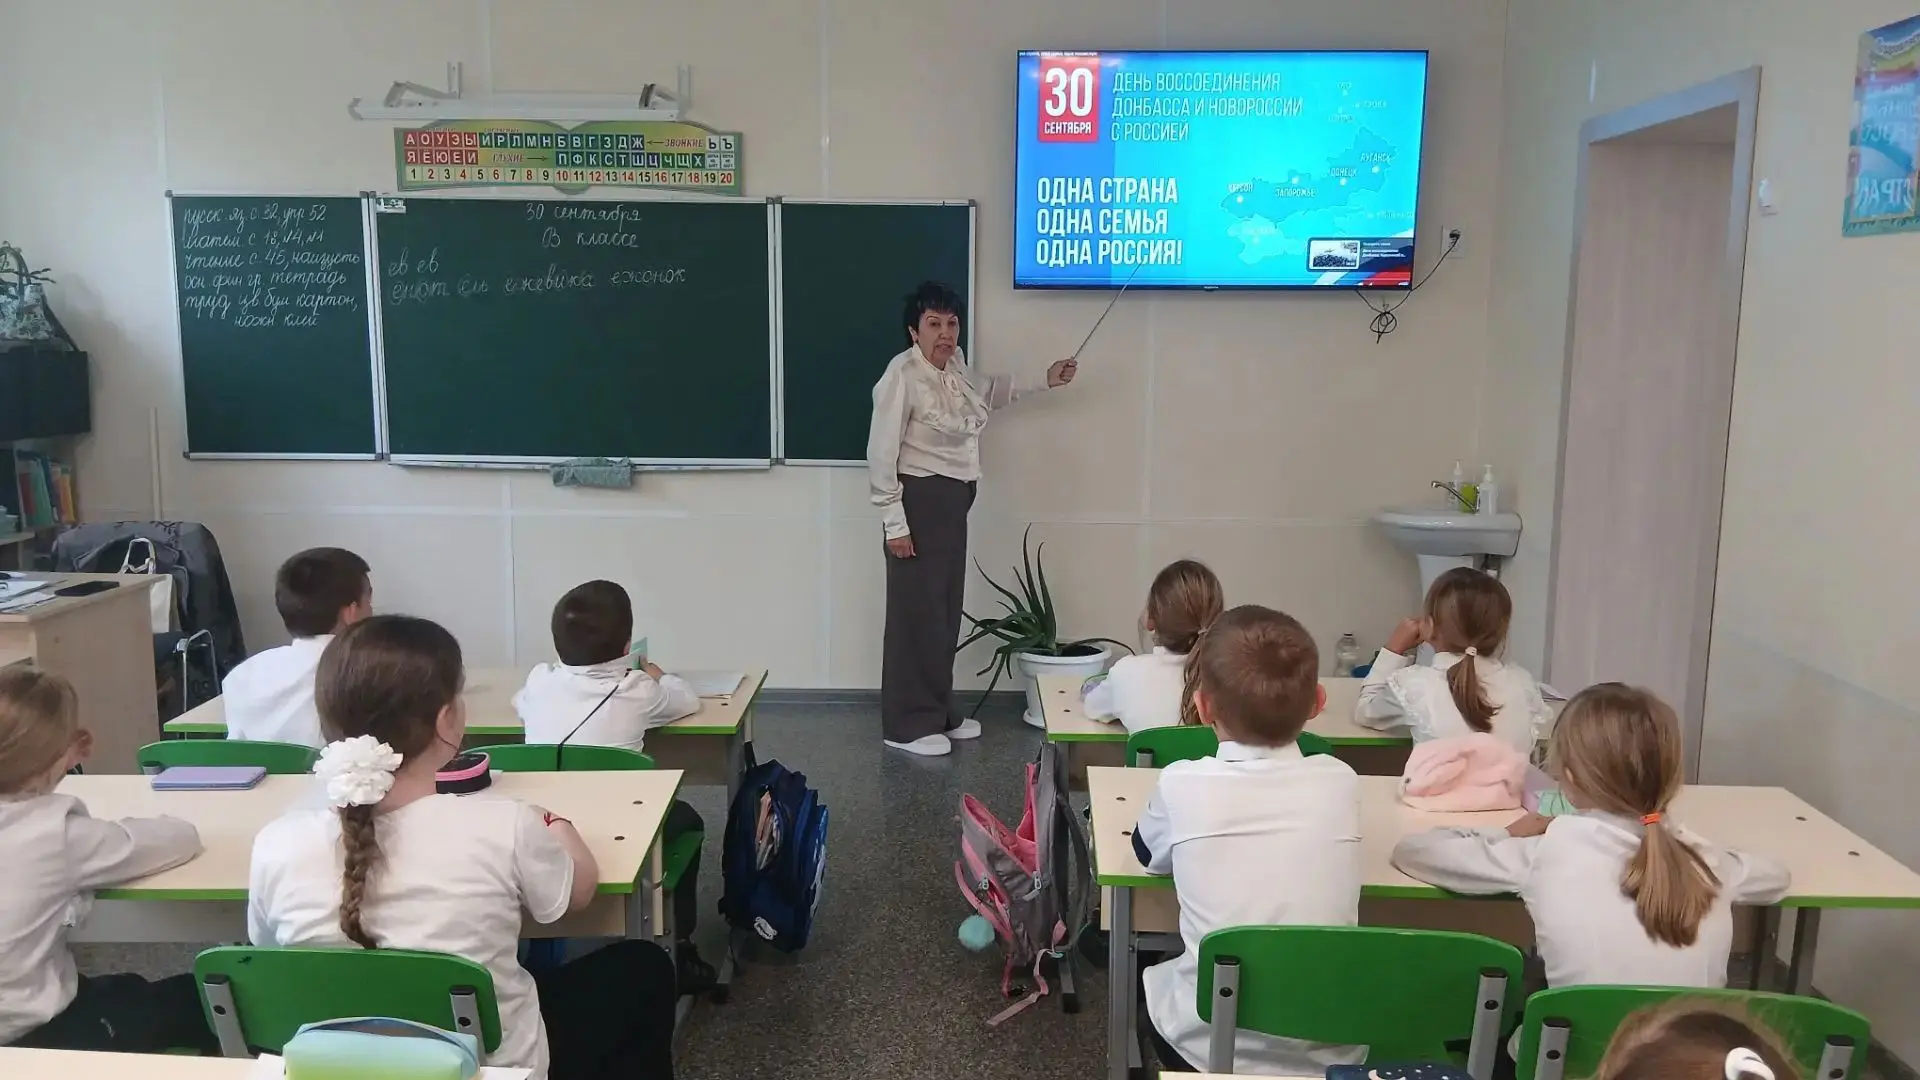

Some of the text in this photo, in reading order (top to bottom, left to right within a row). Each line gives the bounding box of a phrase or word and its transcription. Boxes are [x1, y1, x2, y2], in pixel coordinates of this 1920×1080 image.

[1045, 67, 1093, 116] 30
[1113, 72, 1280, 93] ДЕНЬ ВОССОЕДИНЕНИЯ
[1112, 98, 1303, 118] ДОНБАССА И НОВОРОССИИ
[1044, 121, 1091, 134] СЕНТЯБРЯ
[1111, 119, 1189, 141] С РОССИЕЙ
[411, 168, 733, 184] 1 2 3 4 5 6 7 8 9 10 11 12 13 14 15 16 17 18 19 20
[1037, 177, 1178, 206] ОДНА СТРАНА
[1275, 188, 1316, 198] ЗАПОРОЖЬЕ
[309, 204, 327, 222] 52
[526, 203, 642, 233] 30 сентября
[1036, 208, 1168, 237] ОДНА СЕМЬЯ
[542, 226, 639, 248] В классе
[1036, 239, 1183, 268] ОДНА РОССИЯ!
[270, 271, 347, 294] тетрадь
[610, 268, 687, 286] ежонок
[185, 294, 231, 319] труд
[284, 313, 318, 327] клей
